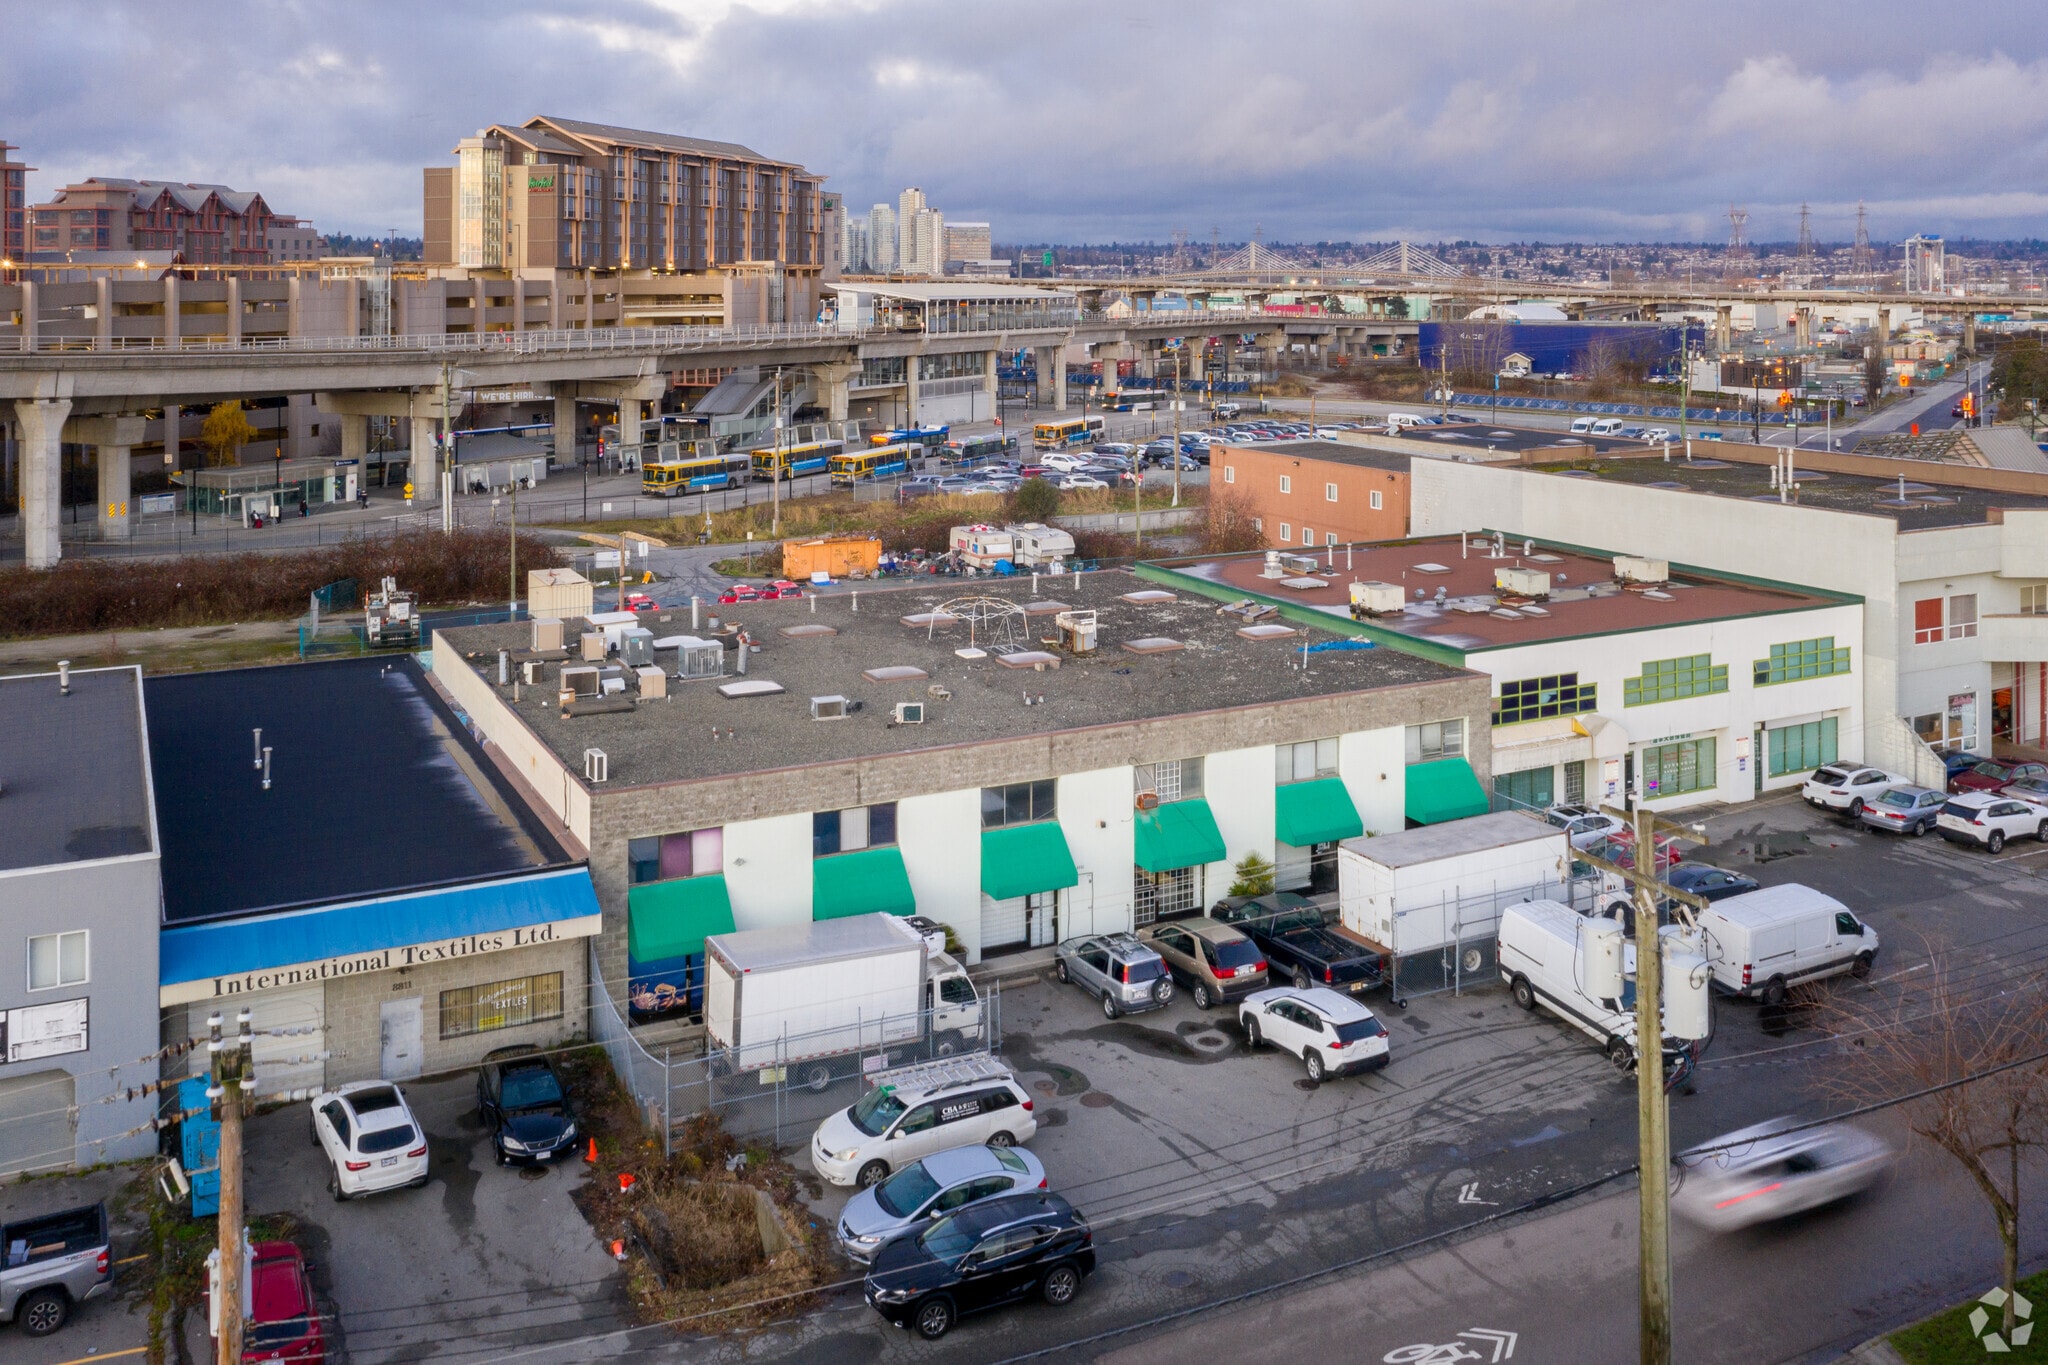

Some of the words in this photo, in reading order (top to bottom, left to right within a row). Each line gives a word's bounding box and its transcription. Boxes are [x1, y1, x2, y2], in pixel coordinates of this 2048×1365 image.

[480, 392, 511, 401] WE'RE
[513, 391, 543, 400] HIRI
[213, 951, 390, 996] International
[401, 936, 503, 965] Textiles
[513, 924, 560, 946] Ltd.
